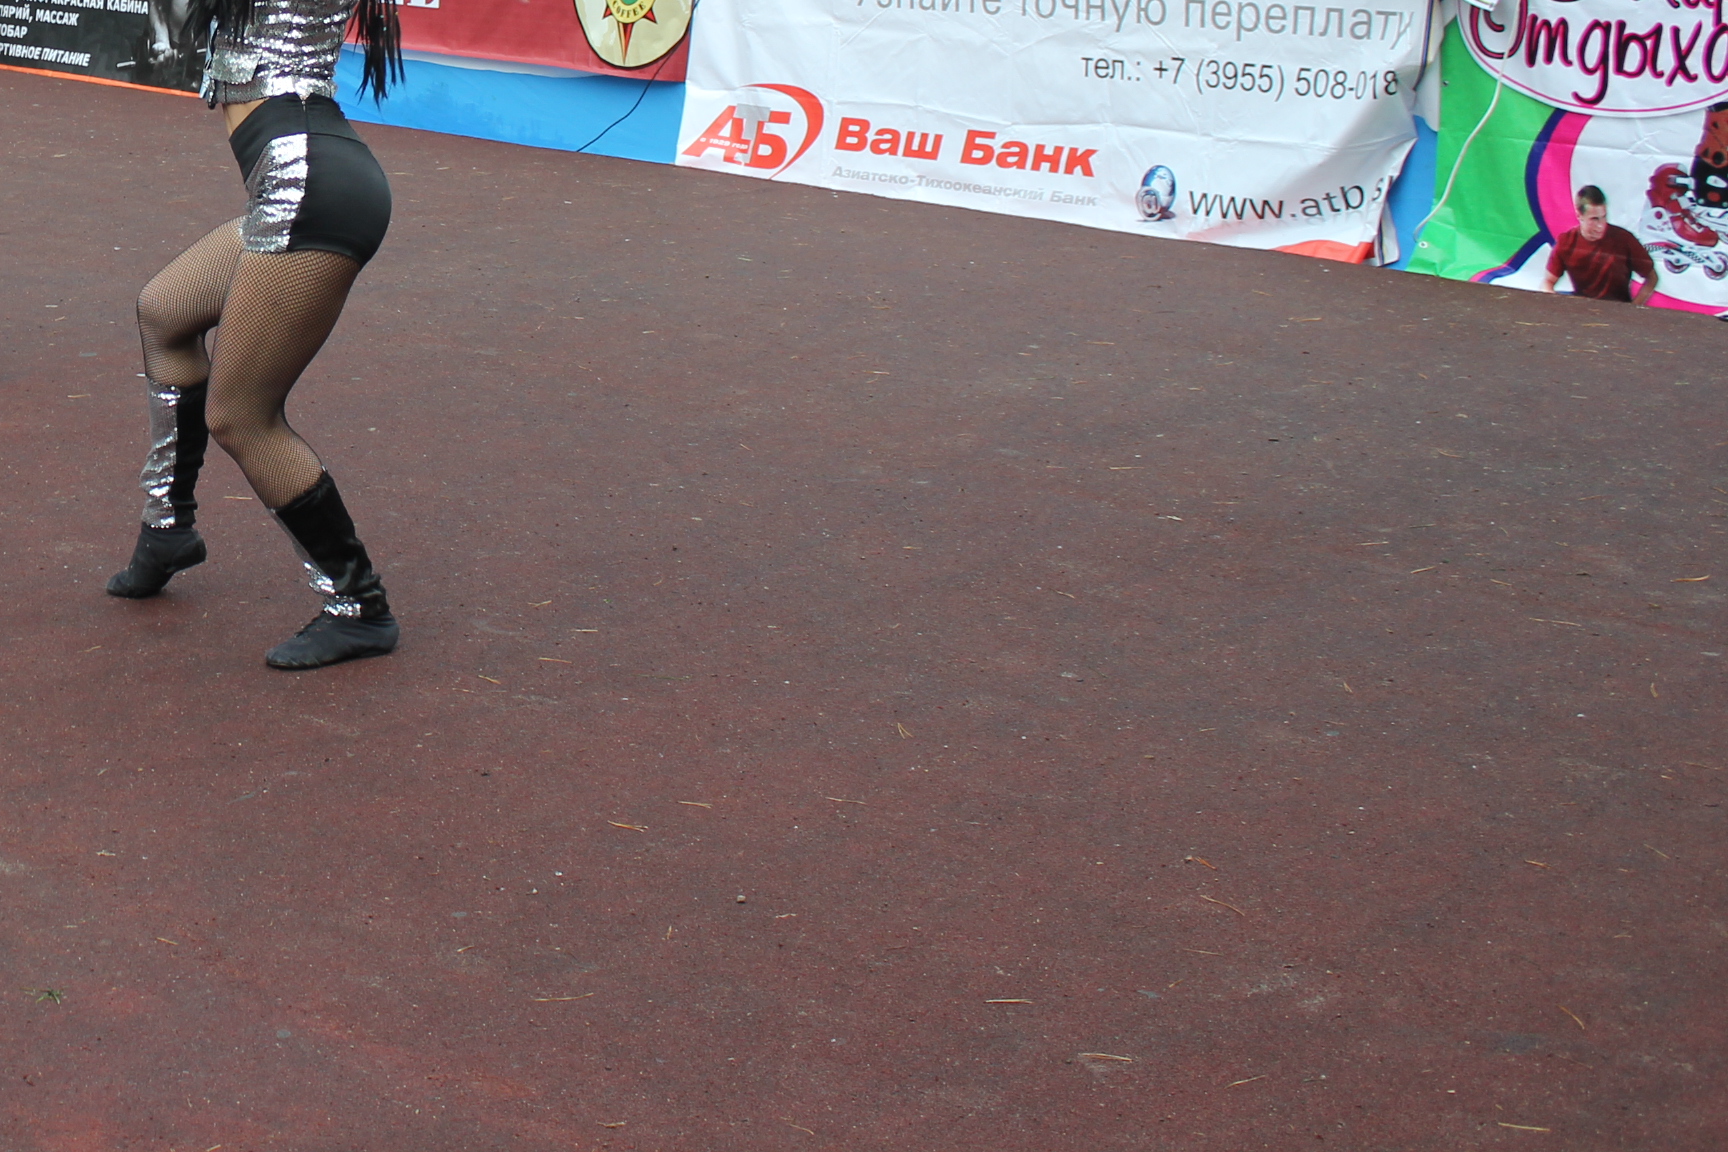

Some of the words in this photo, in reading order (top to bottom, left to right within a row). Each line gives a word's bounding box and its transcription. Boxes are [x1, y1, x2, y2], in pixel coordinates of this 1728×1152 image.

[106, 0, 149, 15] КАБИНА
[611, 0, 647, 19] COFFEE
[35, 9, 80, 26] МАССАЖ
[41, 48, 91, 67] ПИТАНИЕ
[1080, 55, 1142, 83] тел.:
[1152, 56, 1185, 86] +7
[1195, 59, 1285, 102] (3955)
[834, 116, 944, 162] Ваш
[959, 129, 1100, 179] Банк
[831, 165, 1046, 202] Азиатско-Тихоокеанский
[1049, 189, 1099, 208] Банк
